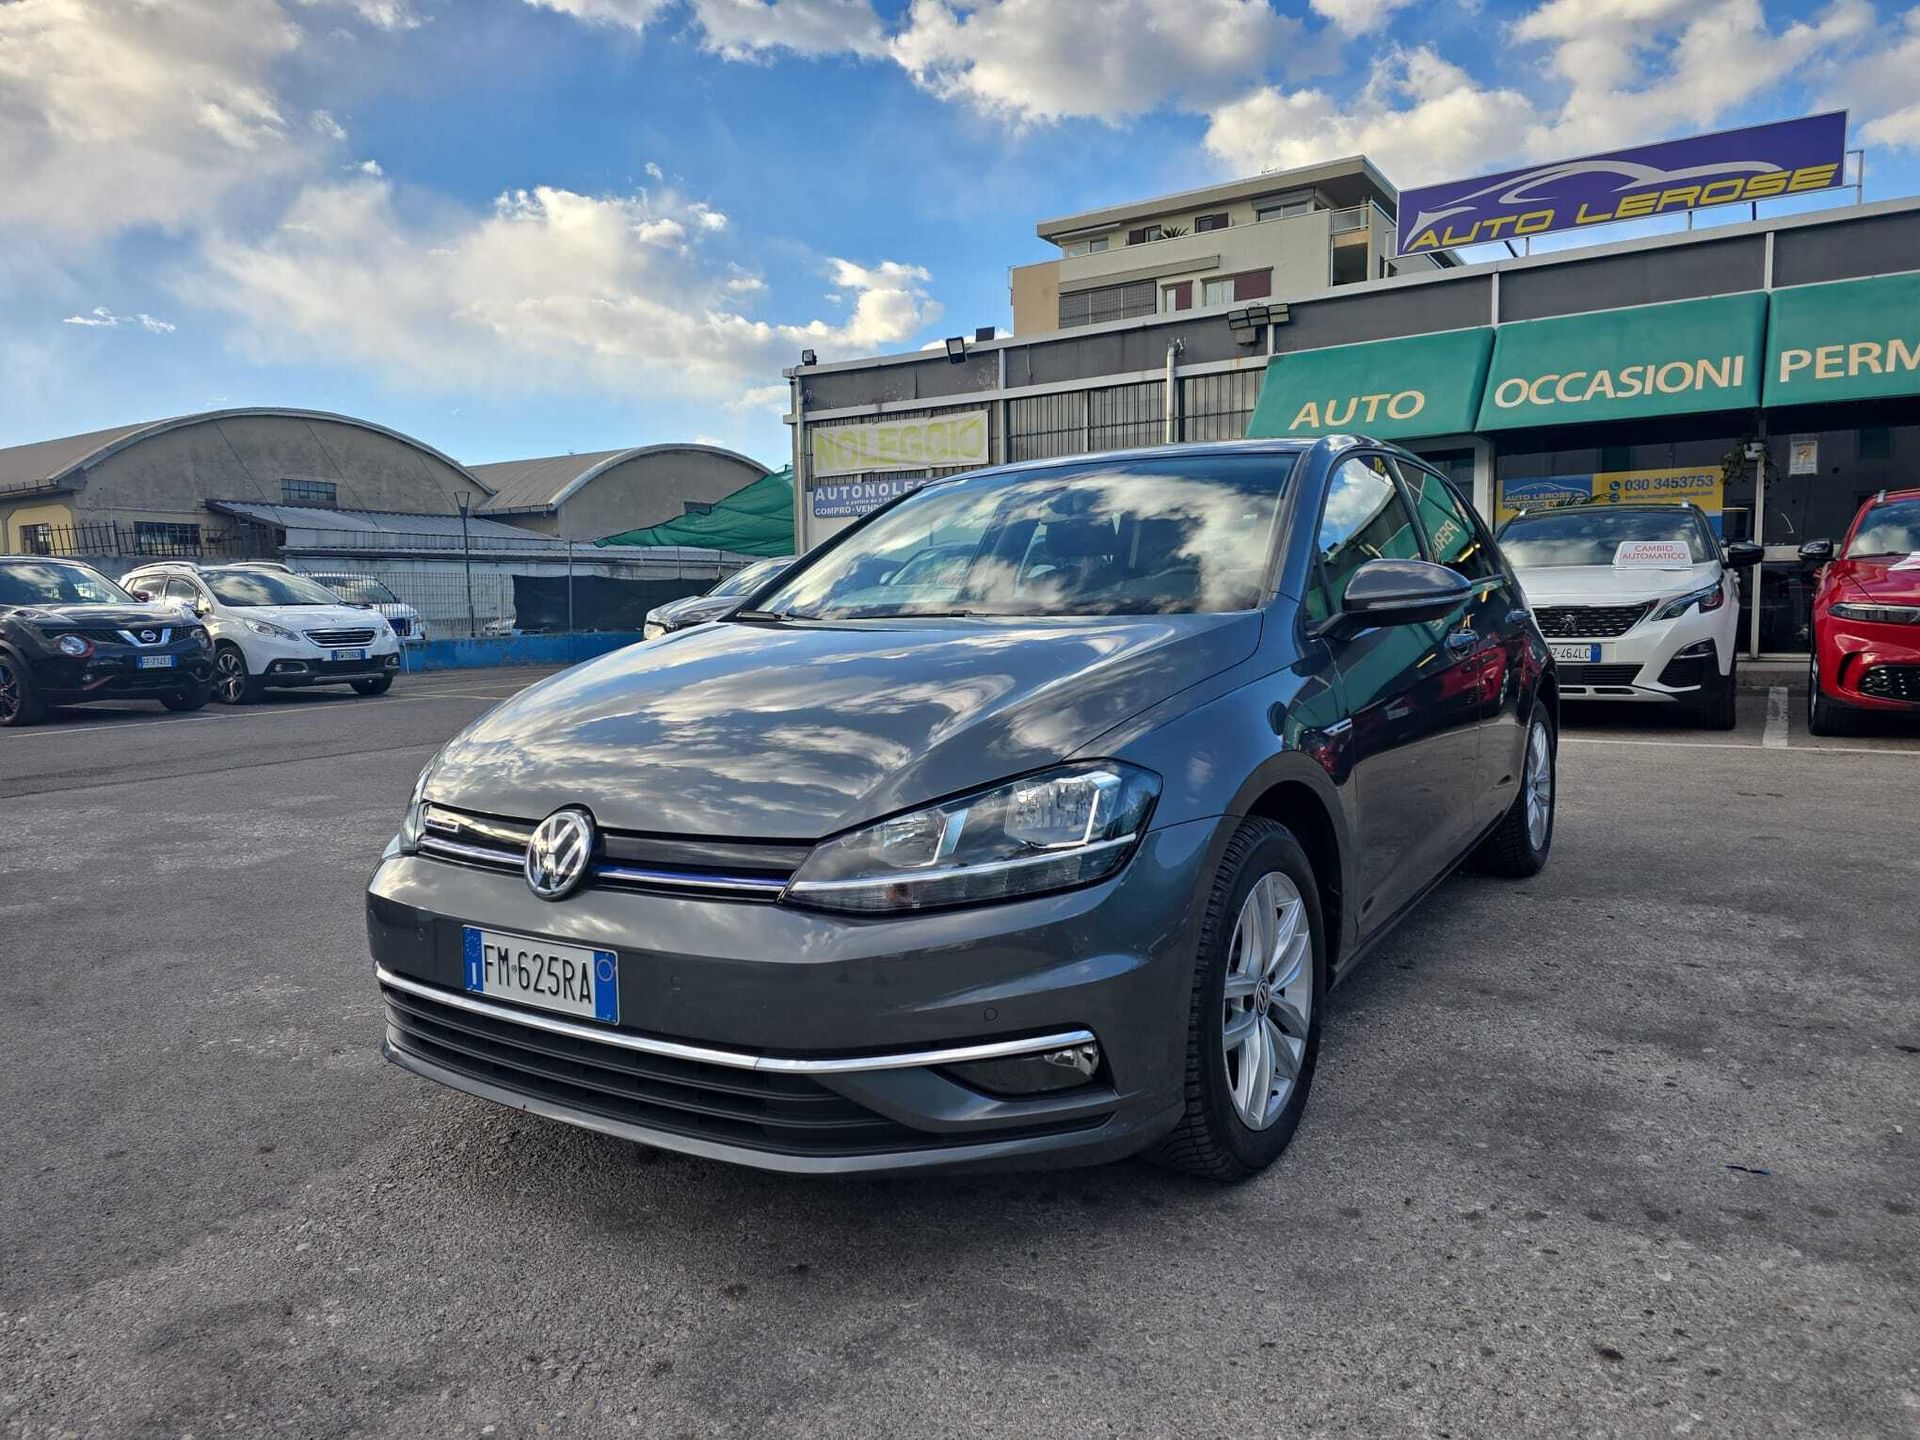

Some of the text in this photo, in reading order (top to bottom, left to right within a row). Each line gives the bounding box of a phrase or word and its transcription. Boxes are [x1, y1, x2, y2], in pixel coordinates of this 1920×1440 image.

[1407, 163, 1840, 252] AUTO LEROSE
[1289, 338, 1920, 430] AUTO OCCASIONI PERM
[815, 418, 985, 470] NOLEGGIO
[1625, 475, 1714, 491] 030 3453753
[815, 506, 851, 516] COMPRO
[1622, 552, 1687, 560] AUTOMATICO
